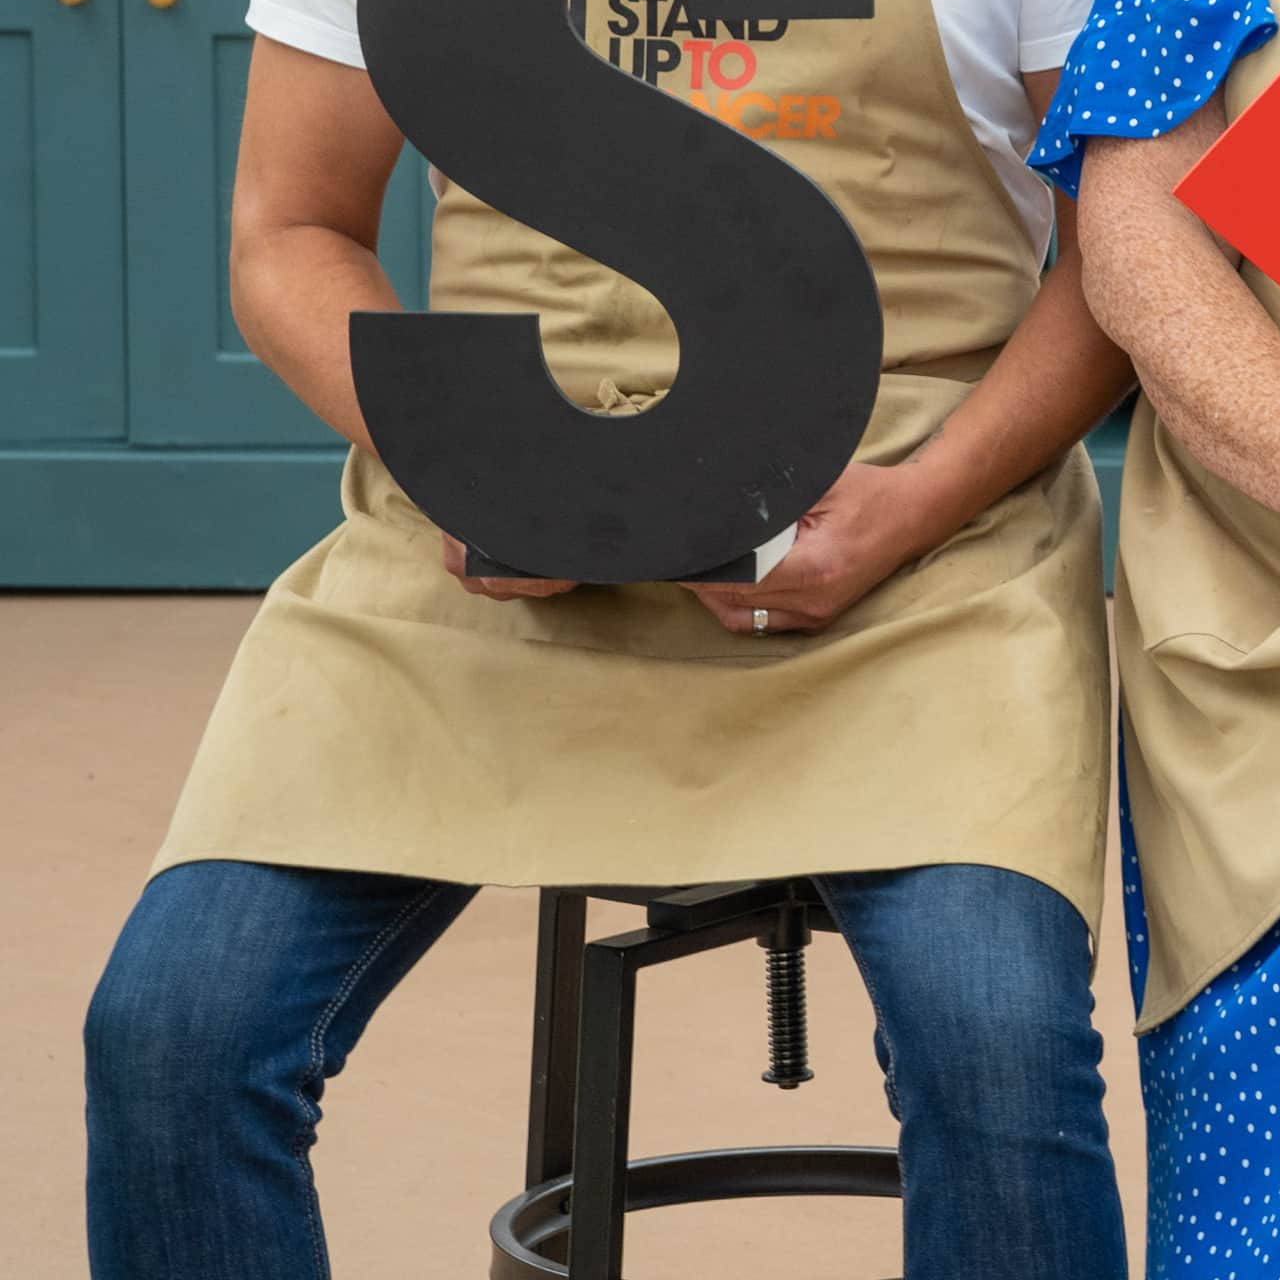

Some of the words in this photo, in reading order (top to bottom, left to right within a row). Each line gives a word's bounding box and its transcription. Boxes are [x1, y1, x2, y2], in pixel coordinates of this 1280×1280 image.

[609, 37, 681, 88] UP
[683, 39, 757, 91] TO
[668, 89, 842, 139] NCER
